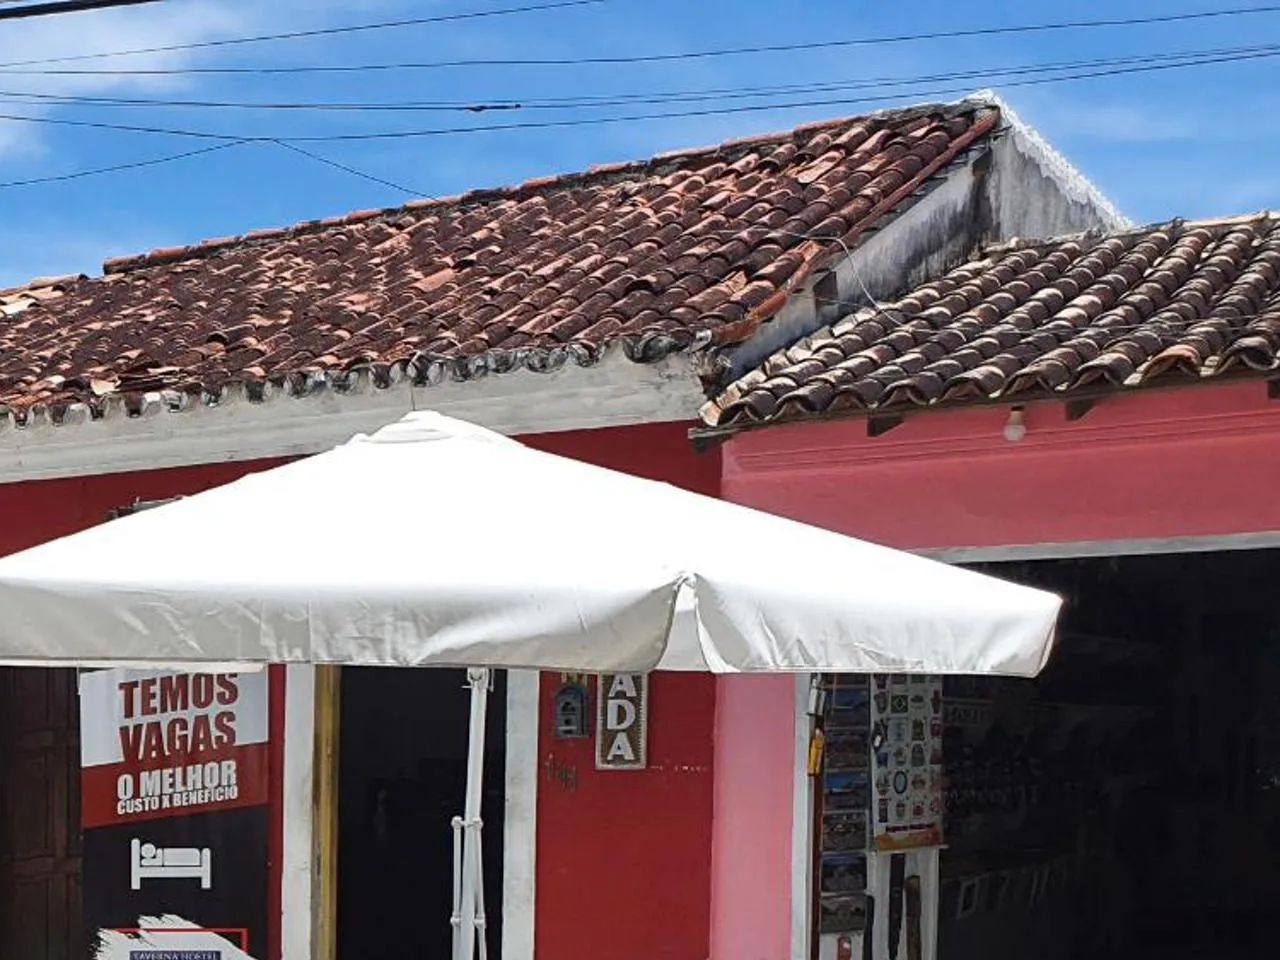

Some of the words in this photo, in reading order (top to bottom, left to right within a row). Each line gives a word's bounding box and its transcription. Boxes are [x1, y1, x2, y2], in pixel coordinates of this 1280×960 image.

[118, 673, 238, 718] TEMOS
[119, 711, 236, 763] VAGAS
[117, 774, 134, 800] O
[140, 760, 237, 797] MELHOR
[117, 797, 159, 814] CUSTO
[162, 795, 170, 809] X
